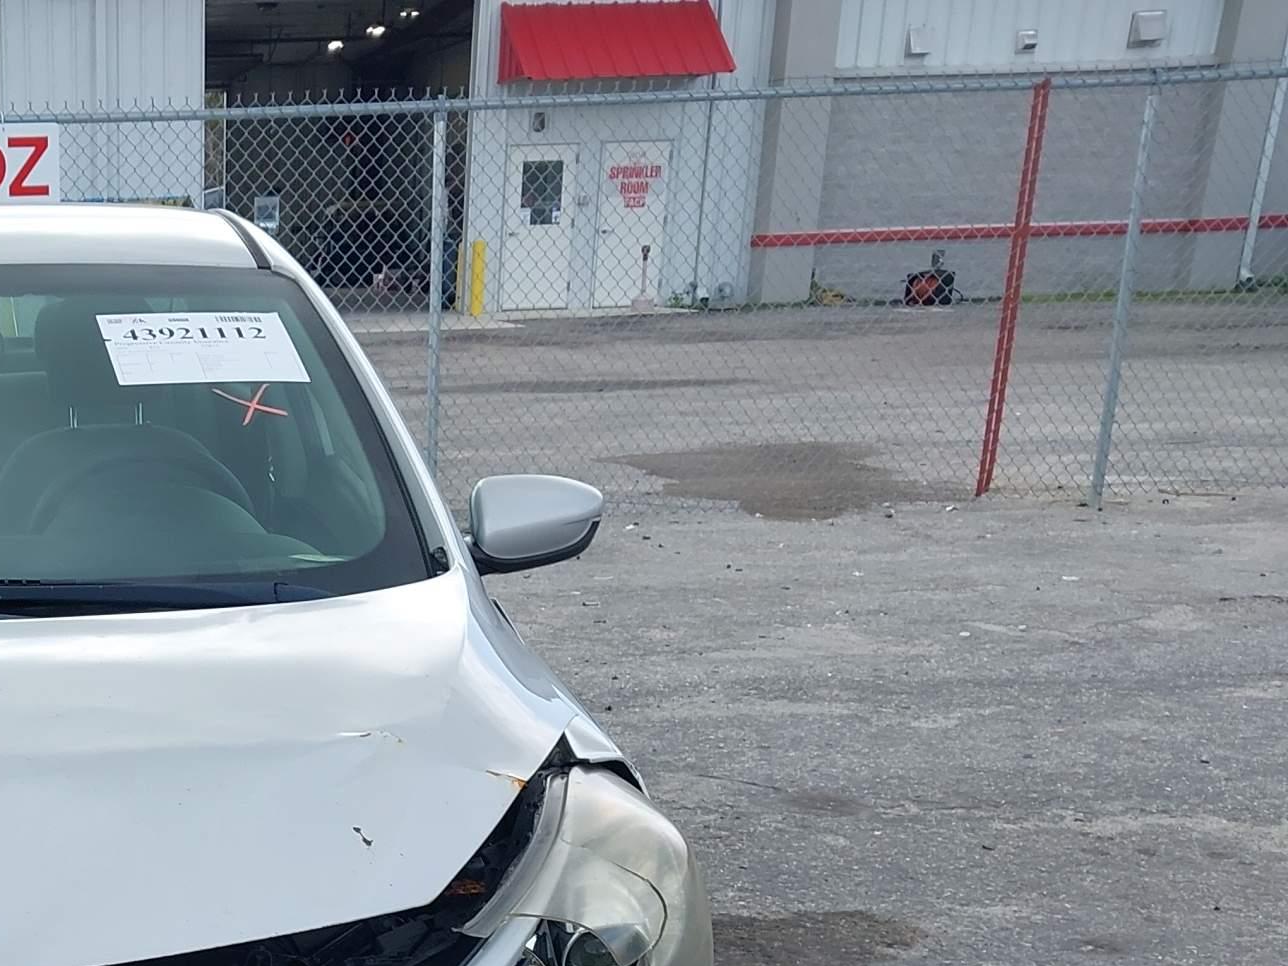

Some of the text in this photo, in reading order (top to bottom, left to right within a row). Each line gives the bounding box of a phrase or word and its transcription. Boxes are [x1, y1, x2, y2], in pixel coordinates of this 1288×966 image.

[609, 165, 661, 179] SPRINKLER
[620, 181, 648, 194] ROOM
[123, 326, 267, 341] 43921112
